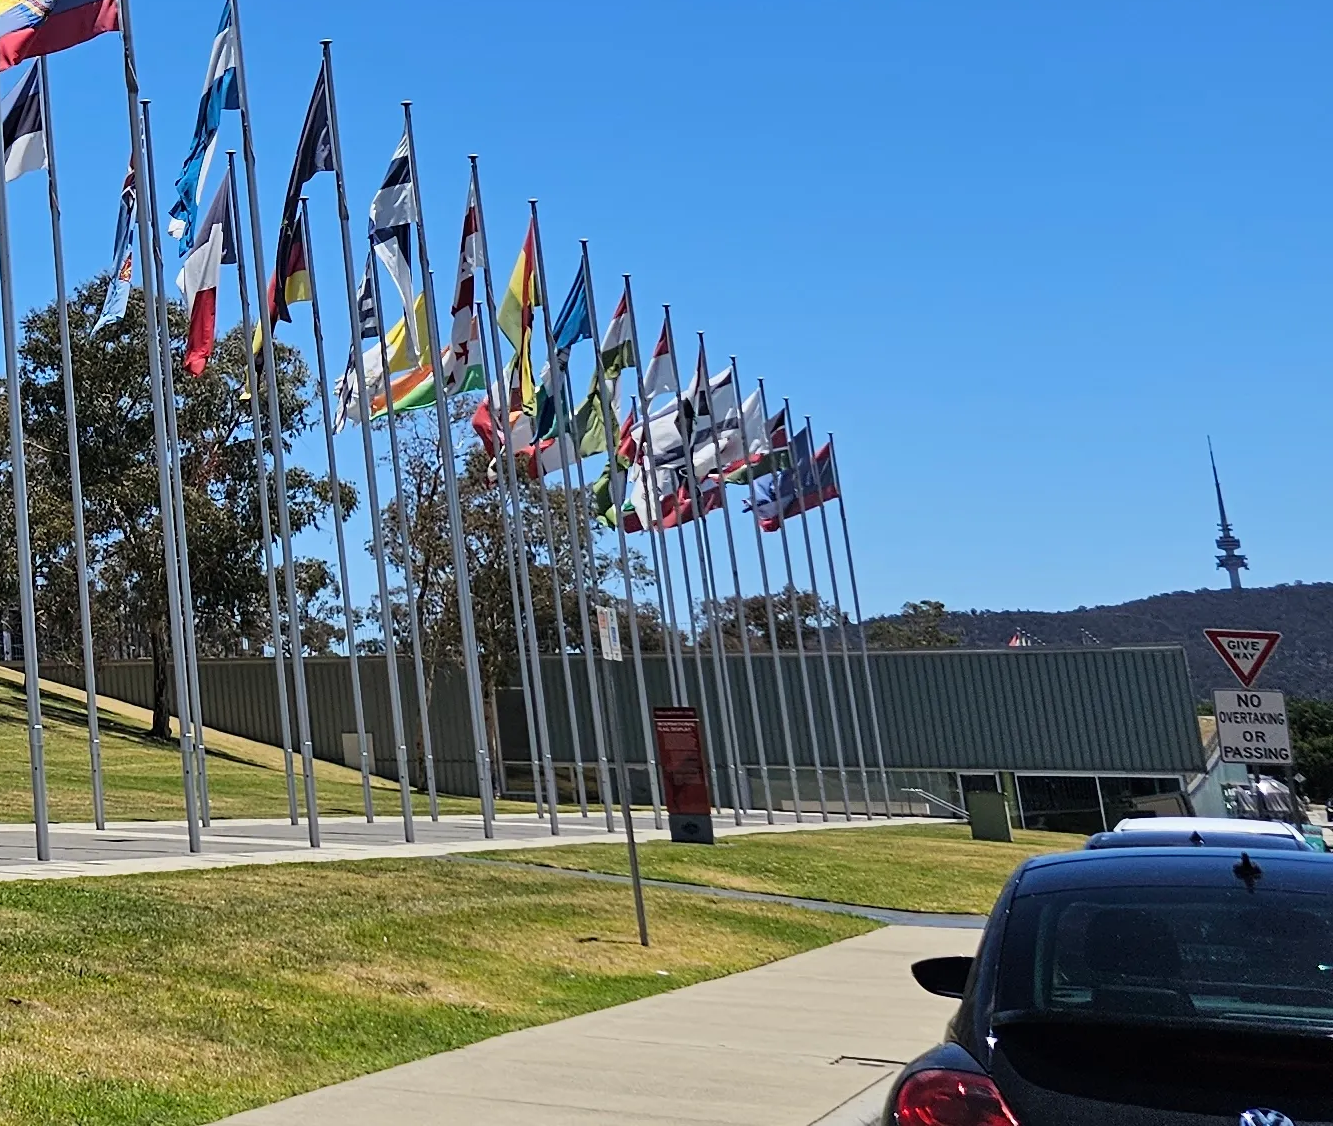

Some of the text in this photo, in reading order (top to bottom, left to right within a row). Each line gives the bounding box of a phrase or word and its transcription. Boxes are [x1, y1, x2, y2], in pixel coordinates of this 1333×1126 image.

[1227, 640, 1260, 651] GIVE
[1233, 652, 1255, 661] WAY
[1236, 693, 1262, 708] NO
[1219, 711, 1285, 725] OVERTAKING
[1242, 730, 1267, 743] OR
[1223, 745, 1290, 761] PASSING
